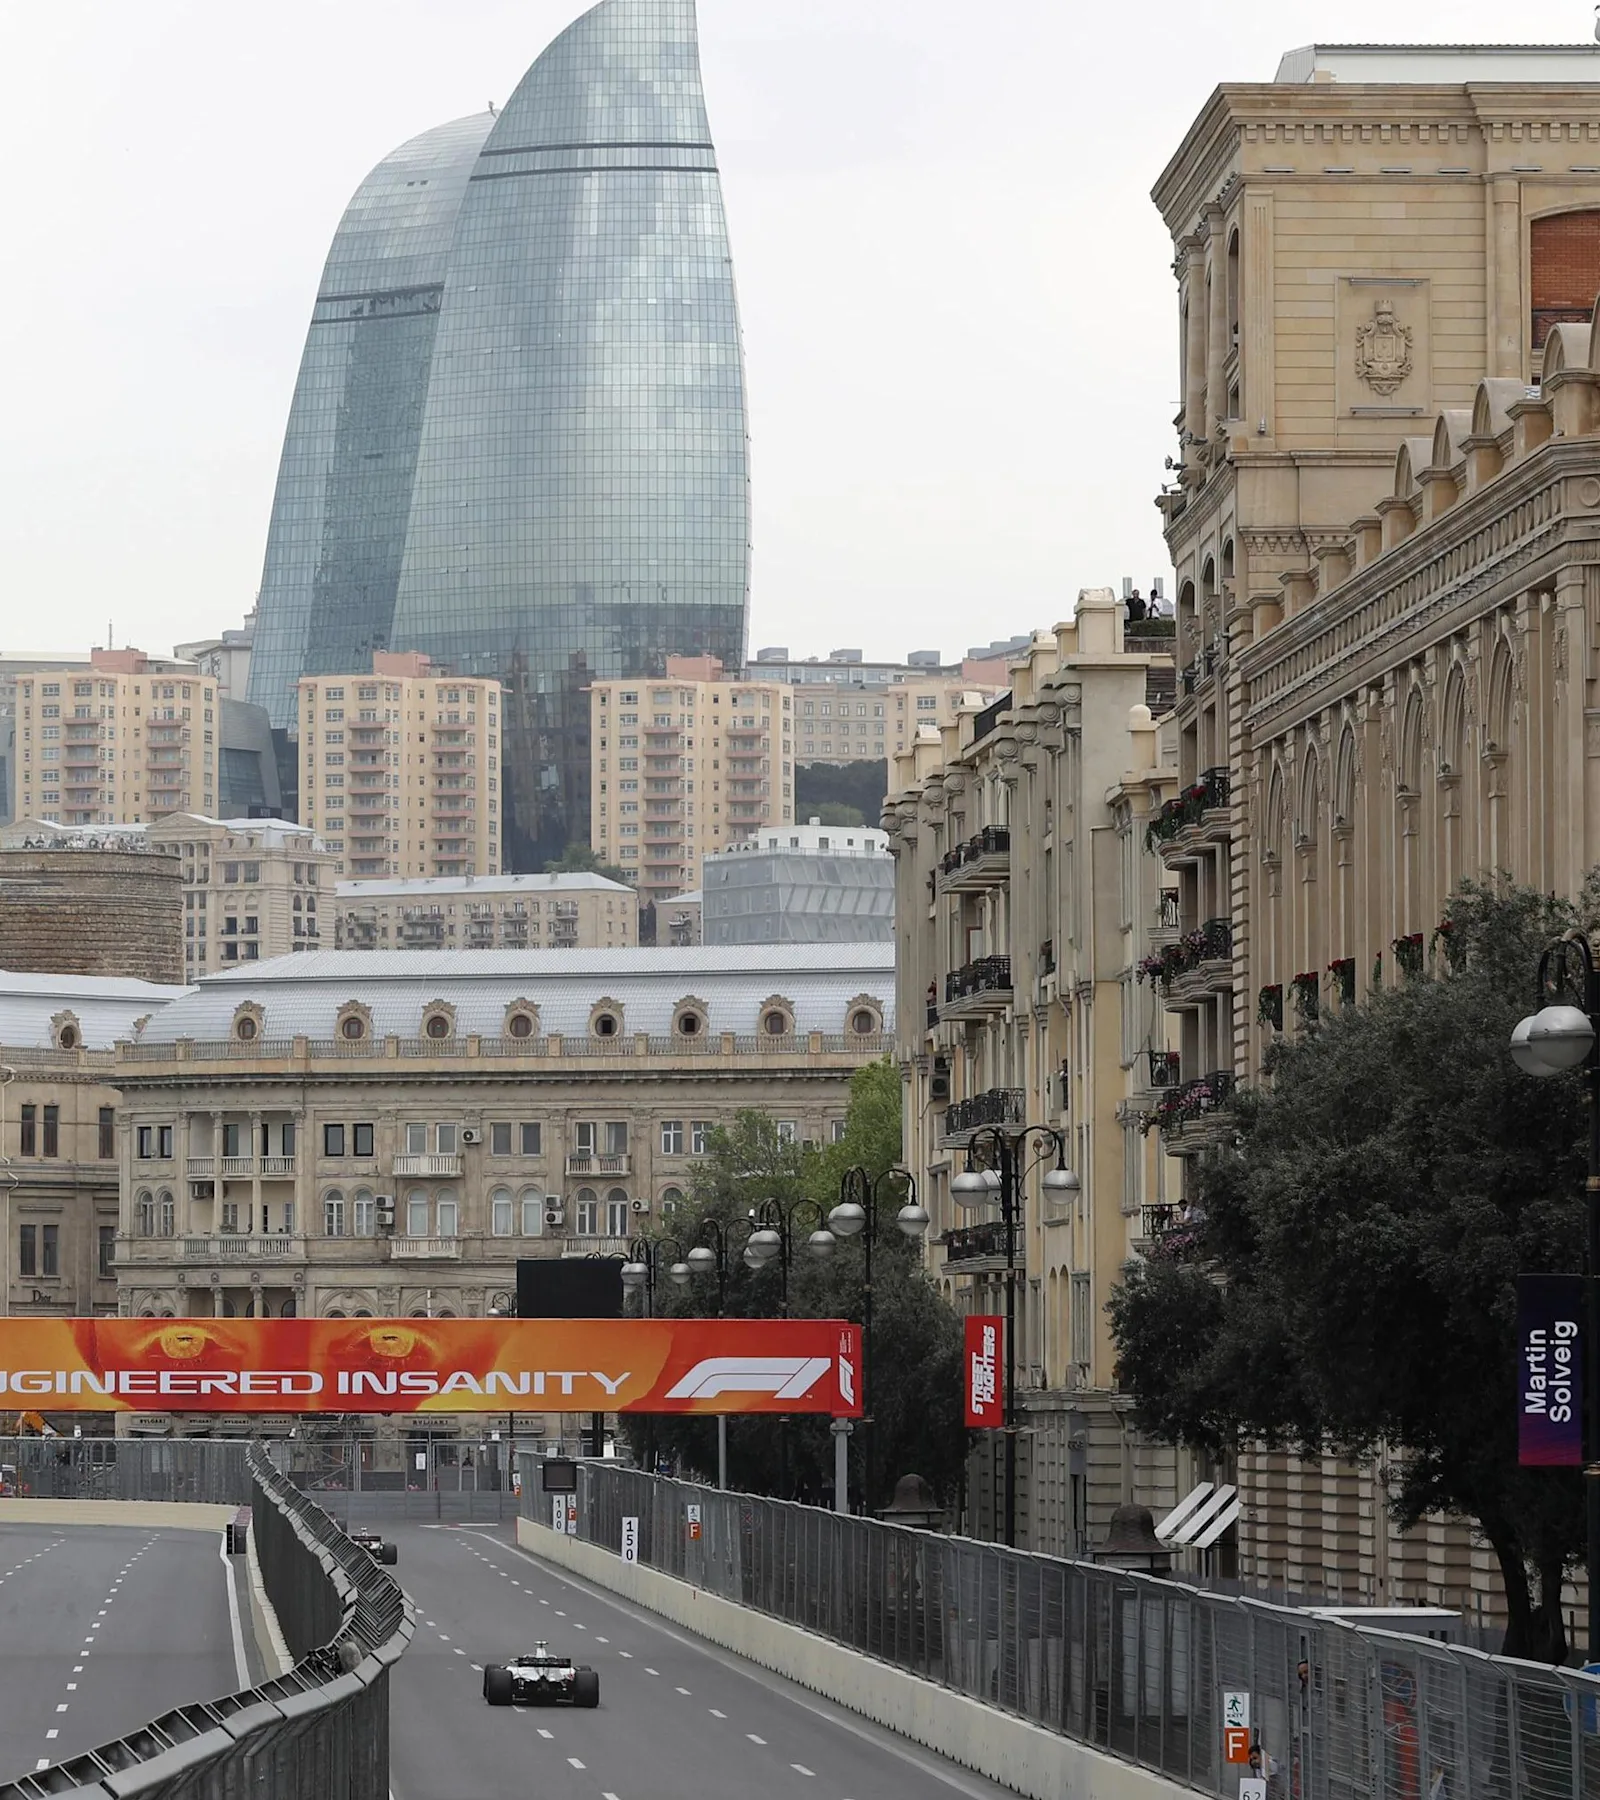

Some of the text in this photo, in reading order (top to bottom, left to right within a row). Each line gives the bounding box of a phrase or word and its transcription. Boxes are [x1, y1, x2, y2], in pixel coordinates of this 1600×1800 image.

[338, 1371, 631, 1395] INSANITY
[971, 1352, 984, 1415] STREET
[983, 1325, 995, 1404] FIGHTERS
[1524, 1329, 1547, 1414] Martin
[1548, 1321, 1578, 1423] Solveig
[569, 1509, 575, 1519] F
[690, 1524, 699, 1538] F
[625, 1520, 635, 1562] 150
[1228, 1732, 1245, 1759] F
